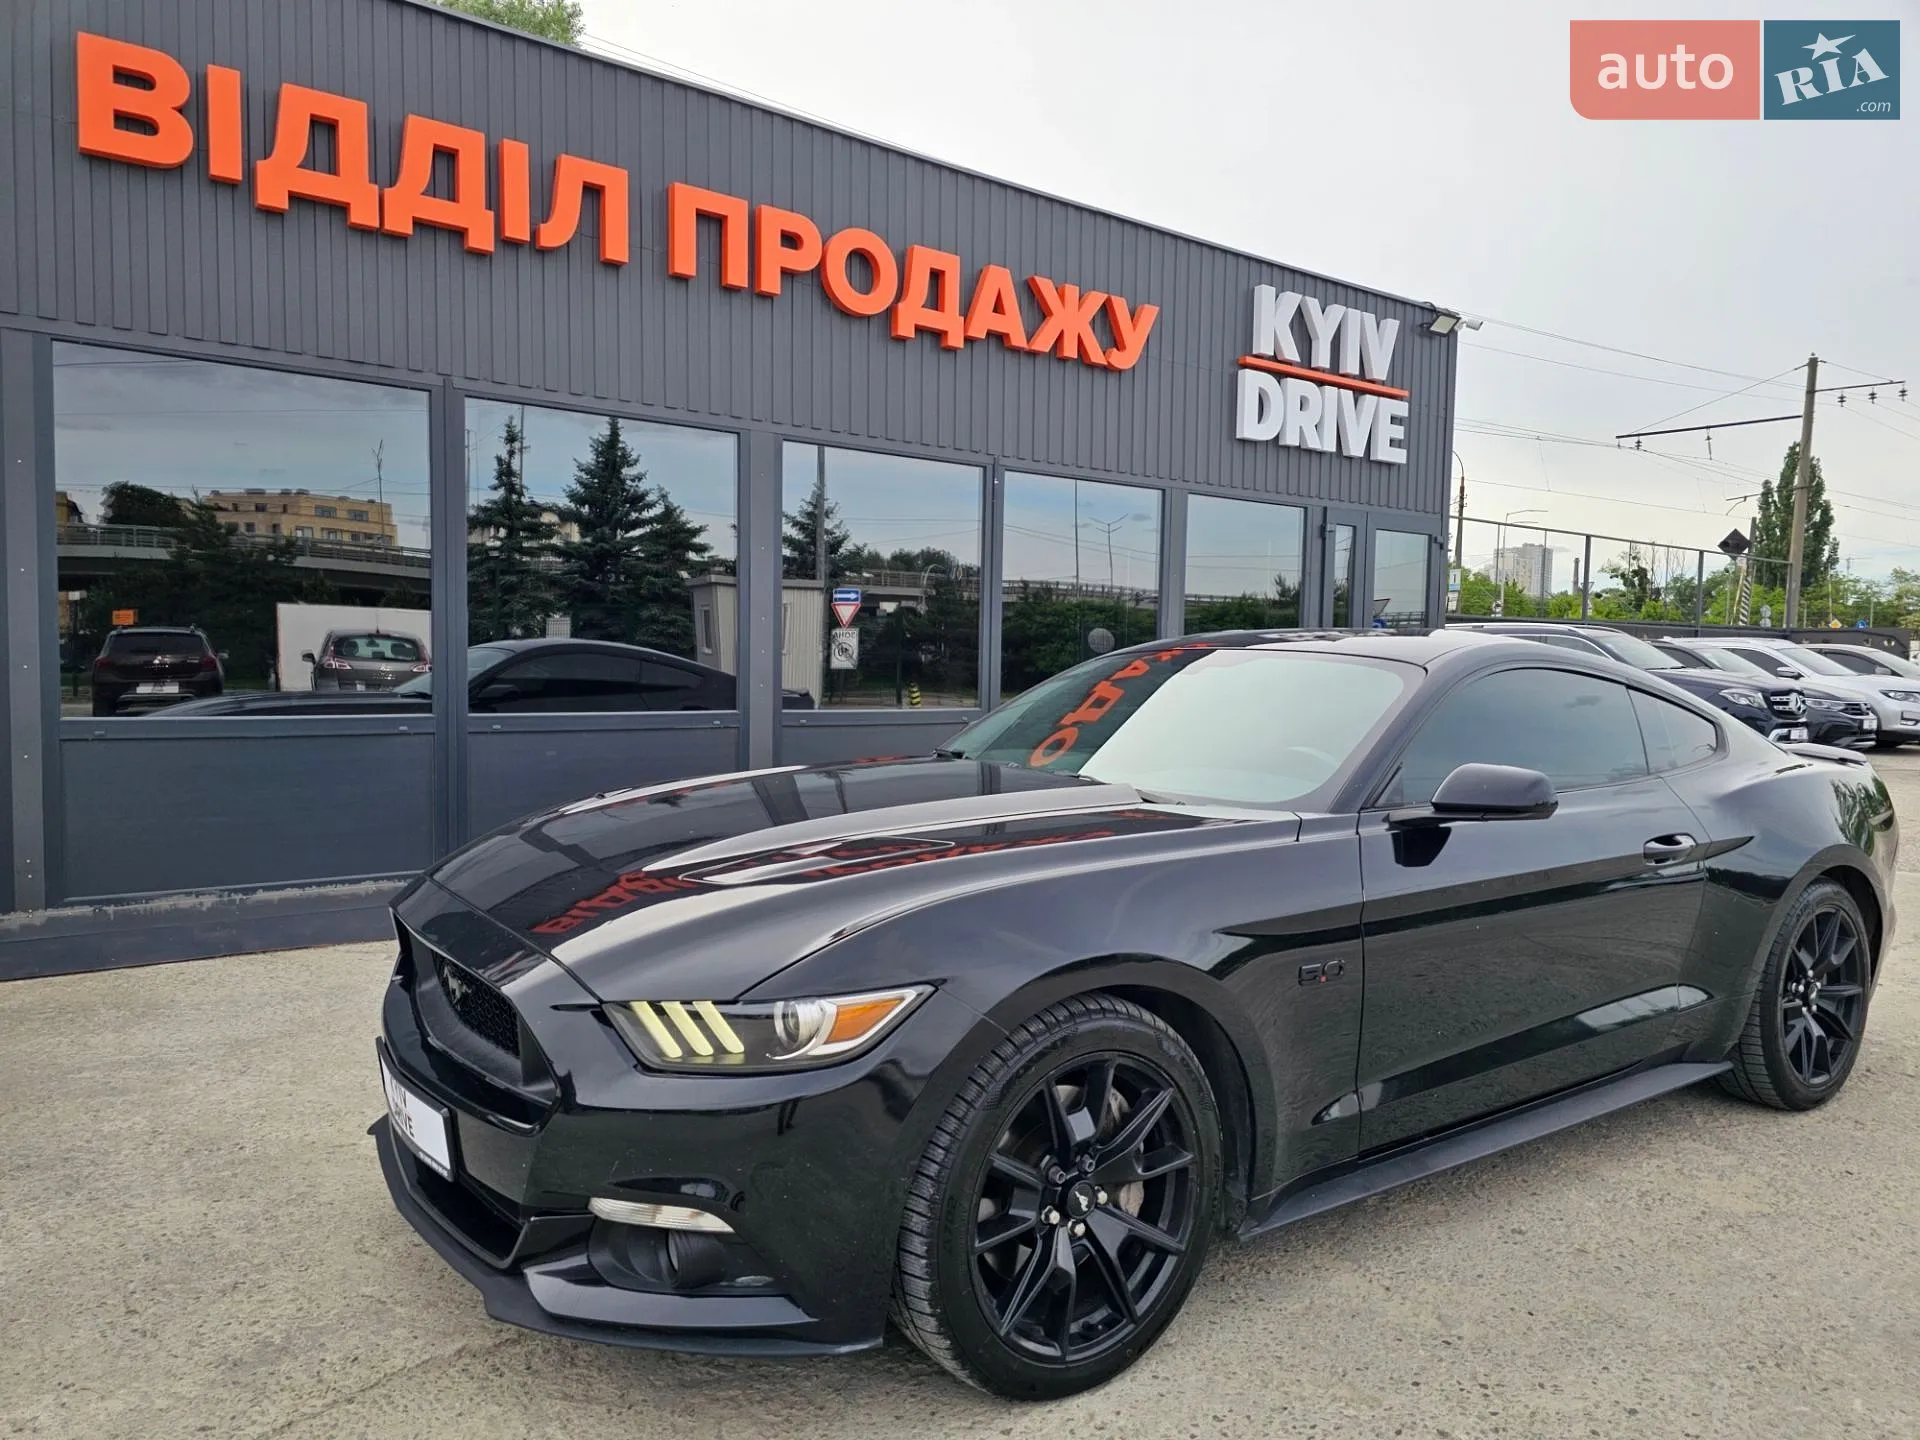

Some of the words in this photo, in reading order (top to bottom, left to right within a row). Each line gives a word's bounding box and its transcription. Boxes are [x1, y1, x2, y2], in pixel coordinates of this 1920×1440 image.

[76, 31, 629, 267] ВІДДІЛ
[668, 182, 1160, 371] ПРОДАЖУ
[1252, 284, 1400, 381] KYIV
[1236, 368, 1409, 464] DRIVE
